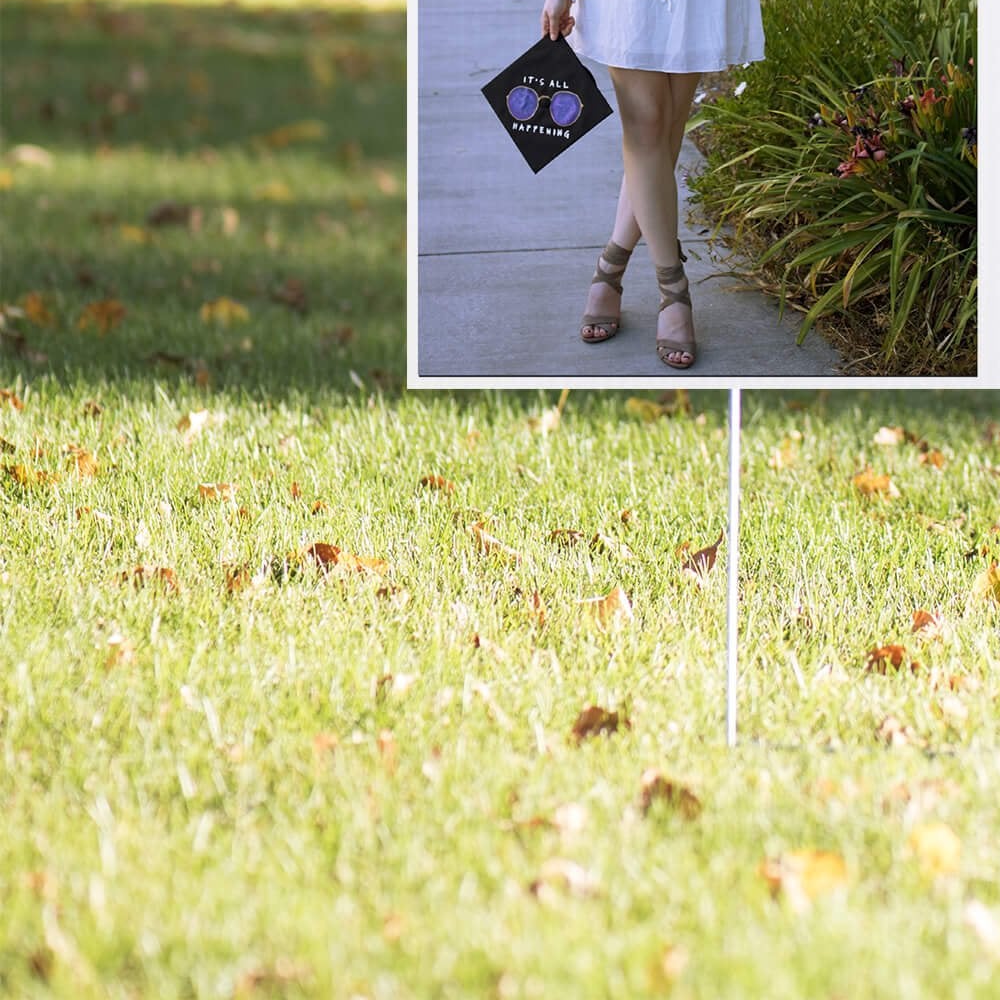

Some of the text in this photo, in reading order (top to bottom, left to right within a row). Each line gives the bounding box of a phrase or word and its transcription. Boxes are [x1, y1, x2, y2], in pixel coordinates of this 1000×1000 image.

[523, 76, 569, 89] IT'S ALL
[512, 122, 570, 139] HAPPENING
